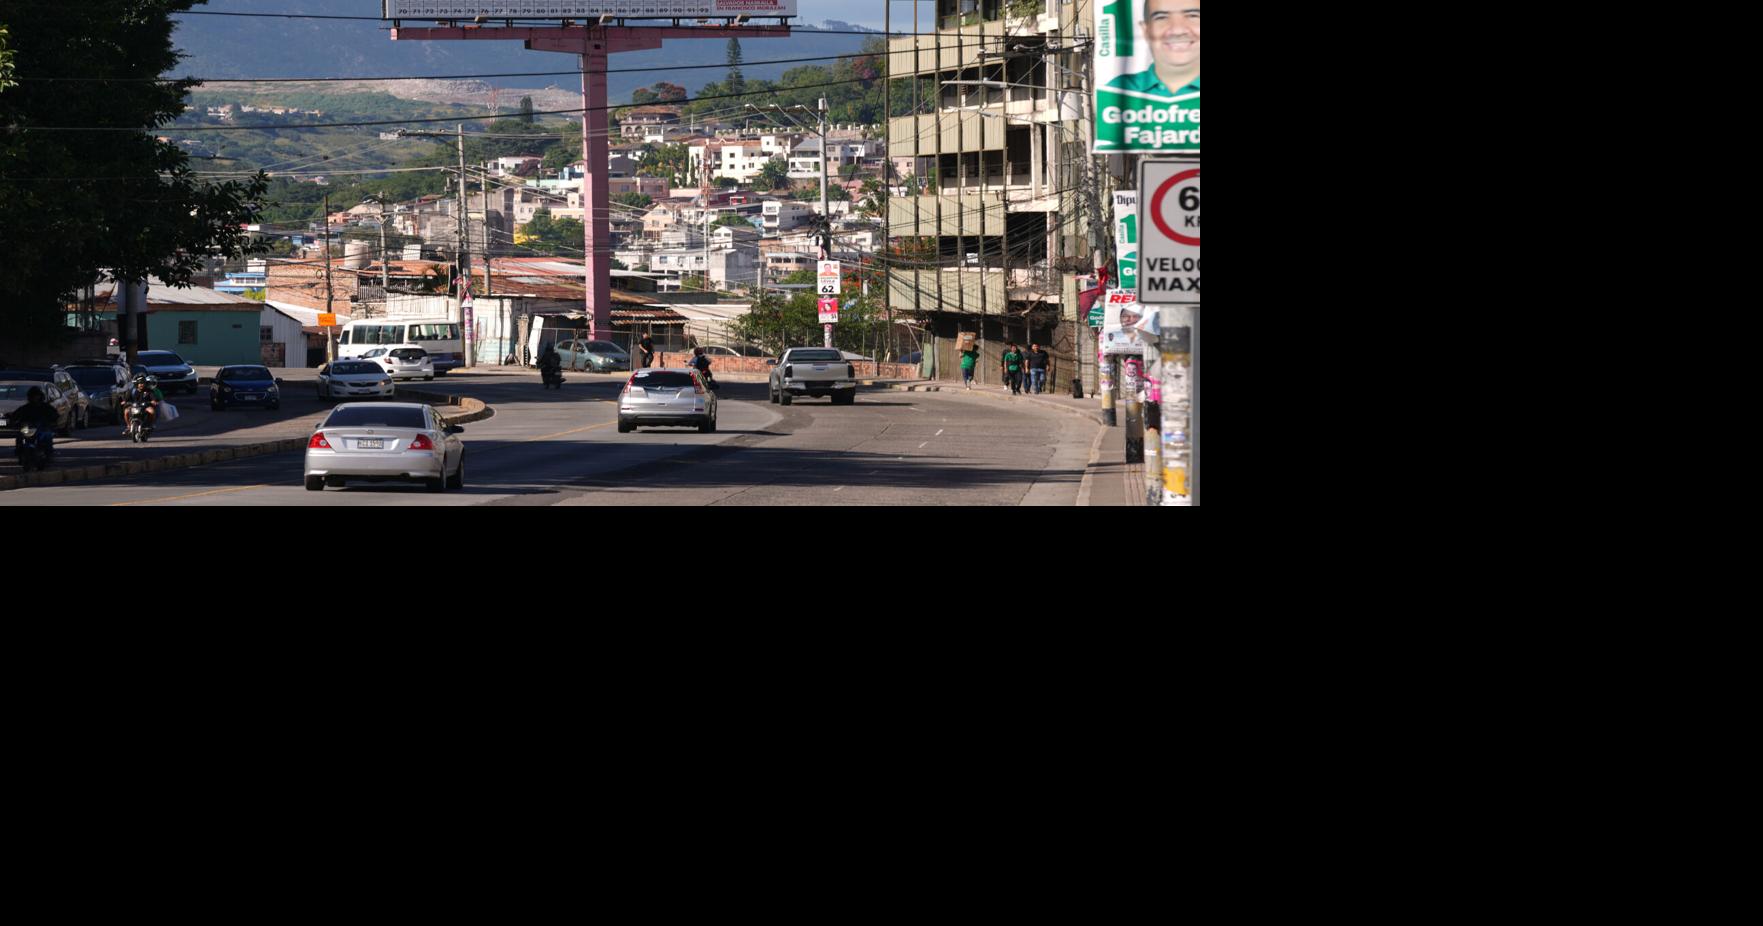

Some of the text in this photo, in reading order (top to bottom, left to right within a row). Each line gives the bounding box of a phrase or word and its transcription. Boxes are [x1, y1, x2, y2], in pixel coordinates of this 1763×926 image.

[1099, 18, 1110, 56] Casilla
[1185, 216, 1200, 228] K
[1146, 257, 1200, 272] VELO
[822, 285, 834, 293] 62
